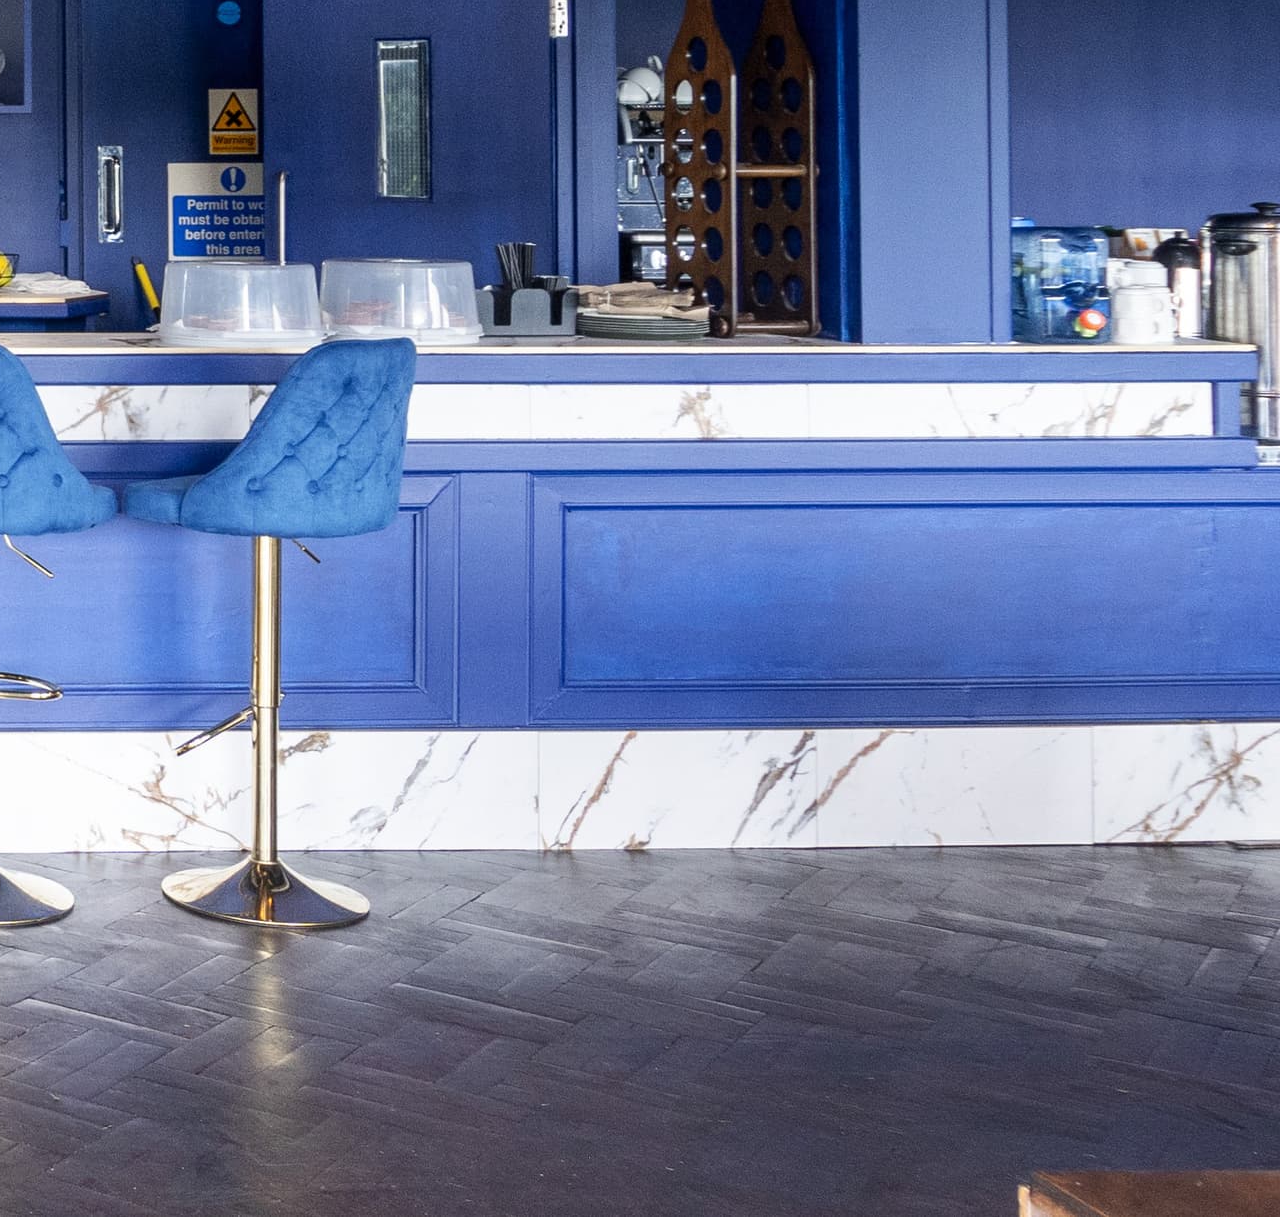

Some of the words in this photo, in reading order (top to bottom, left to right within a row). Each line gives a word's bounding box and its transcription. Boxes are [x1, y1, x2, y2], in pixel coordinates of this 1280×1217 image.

[214, 135, 254, 146] Warning
[187, 199, 228, 211] Permit
[232, 199, 245, 211] to
[178, 215, 210, 225] must
[214, 214, 230, 225] be
[232, 215, 264, 225] obtai
[184, 229, 226, 241] before
[206, 243, 230, 255] this
[233, 245, 260, 255] area
